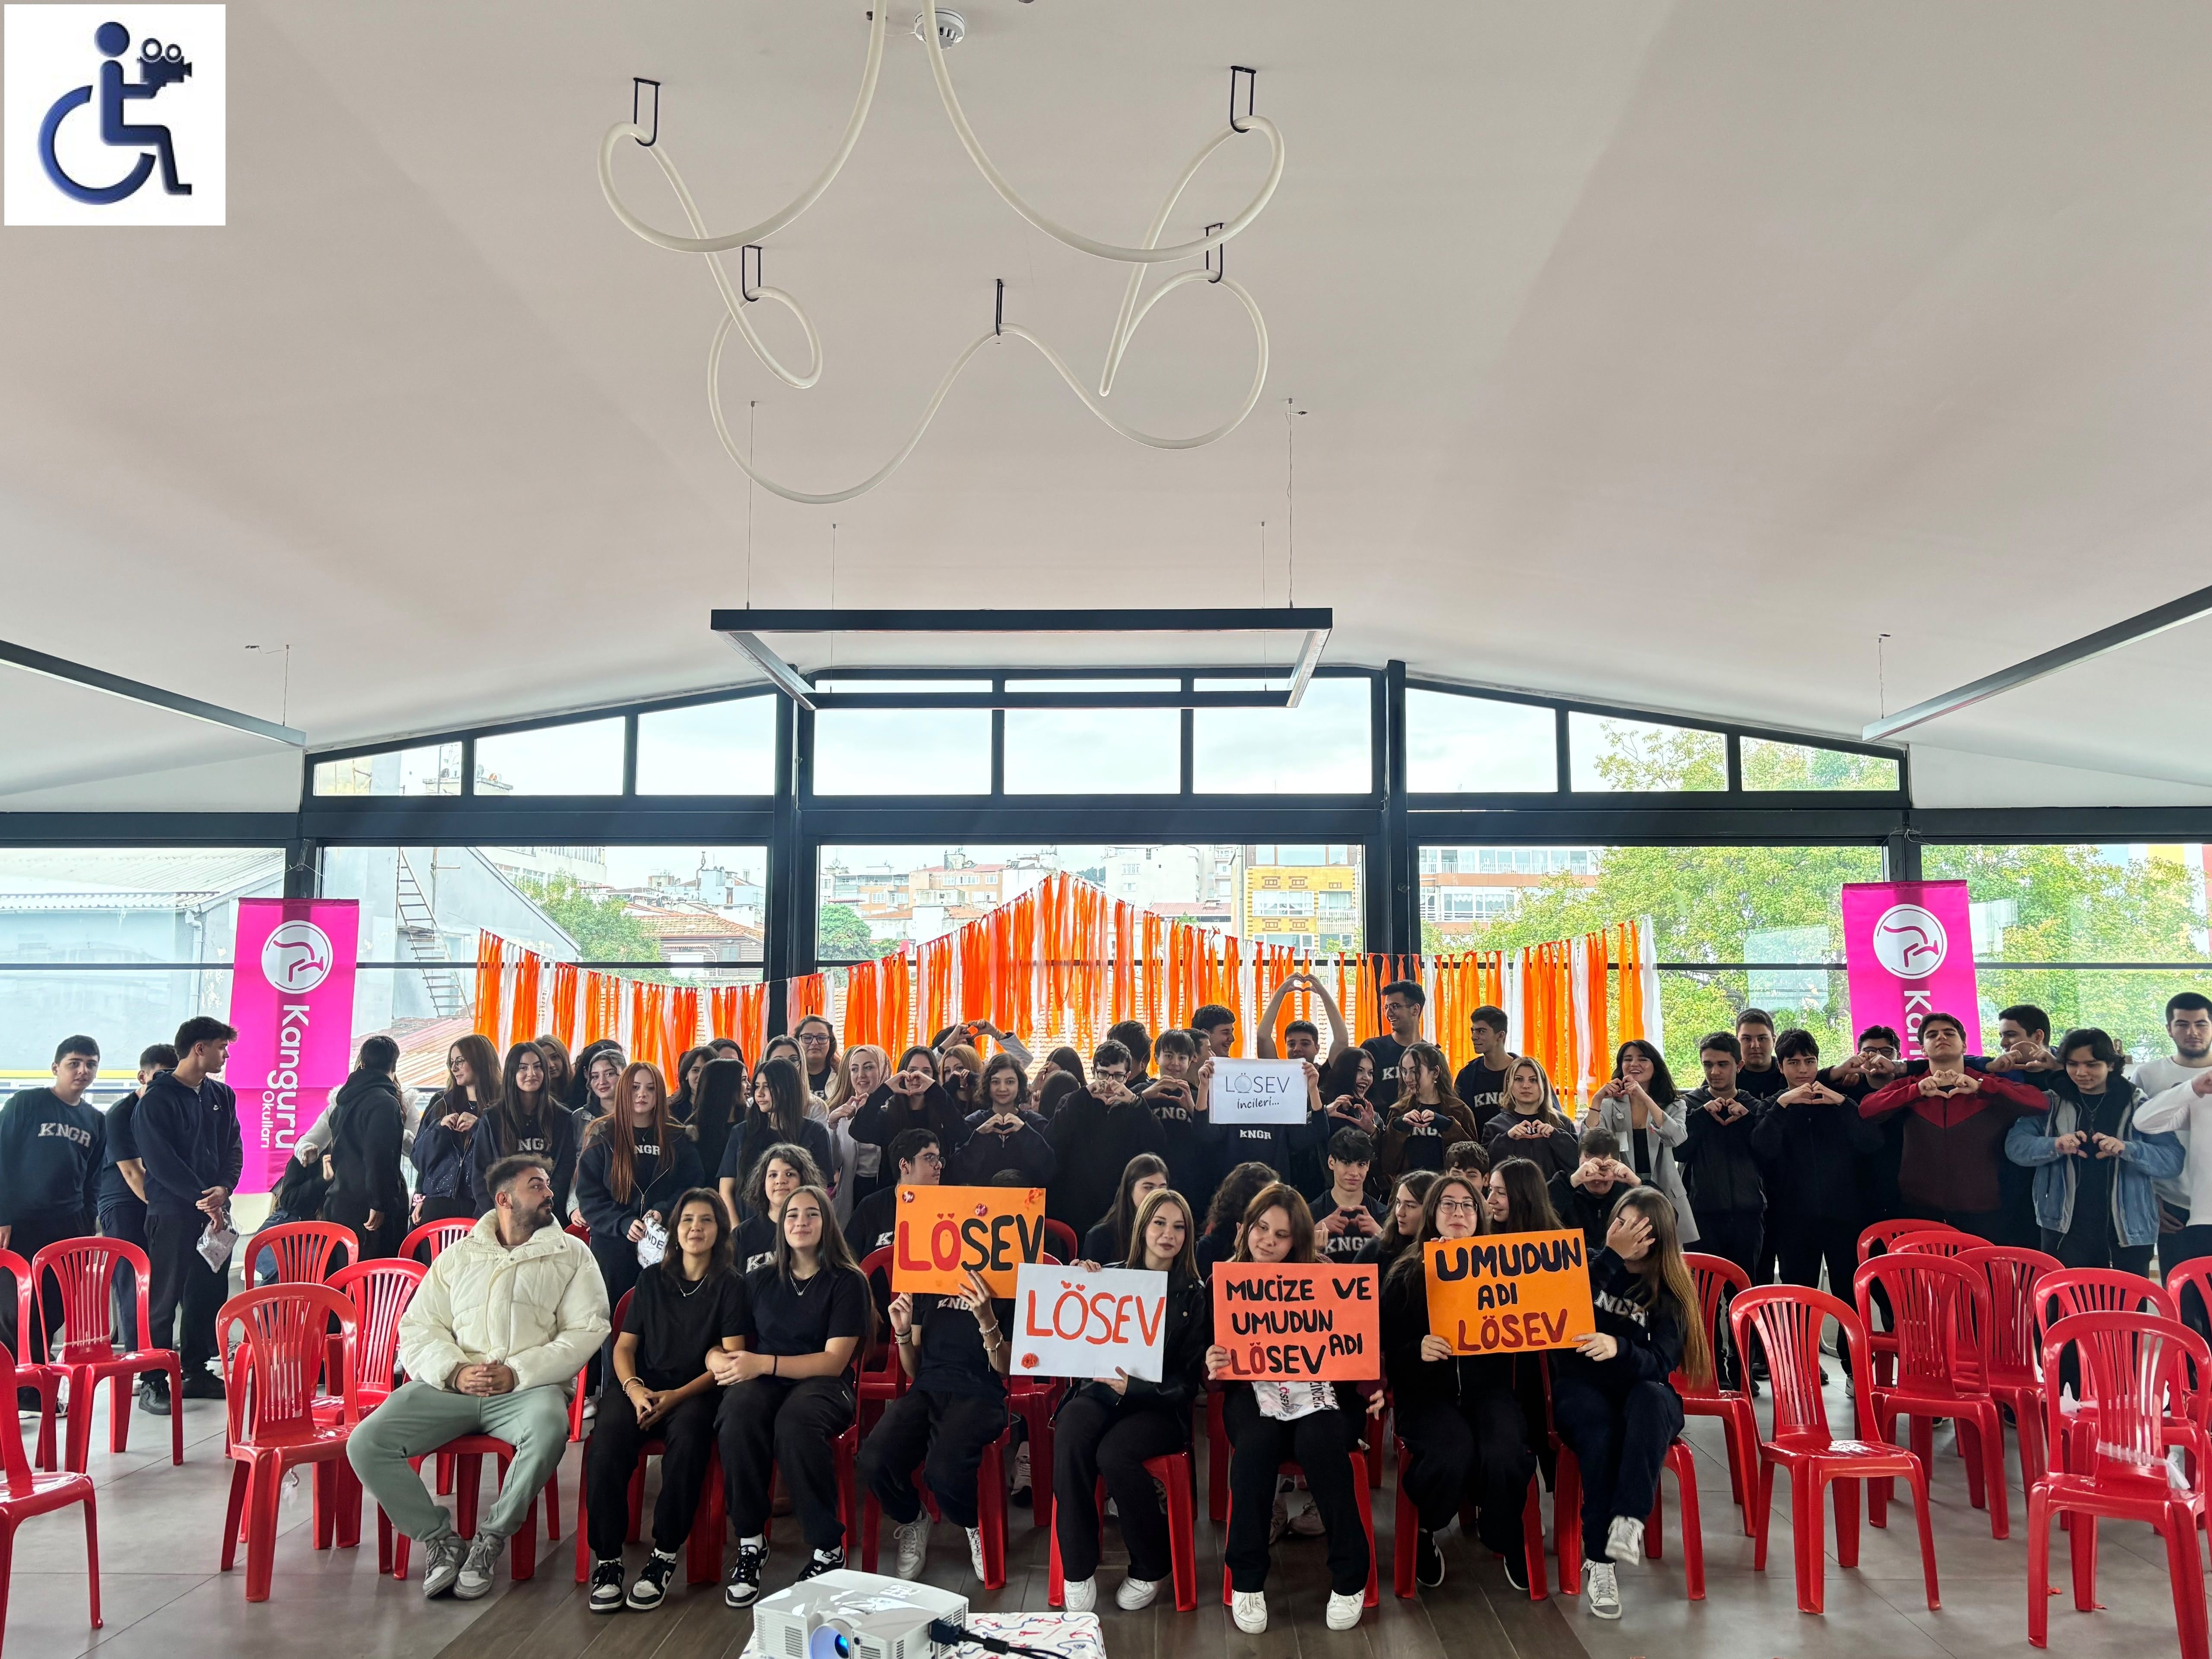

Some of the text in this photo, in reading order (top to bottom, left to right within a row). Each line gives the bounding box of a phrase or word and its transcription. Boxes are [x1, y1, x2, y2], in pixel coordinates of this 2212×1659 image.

[267, 1004, 310, 1149] Kanguru
[1226, 1072, 1290, 1093] LÖSEV
[1153, 1107, 1192, 1123] KNG
[39, 1122, 91, 1148] KNGR
[1239, 1129, 1271, 1140] KNGR
[634, 1144, 660, 1156] NGR
[898, 1213, 1044, 1271] LÖSEV
[1323, 1236, 1372, 1255] KNG
[1435, 1237, 1582, 1281] UMUDUN
[1226, 1274, 1372, 1302] MUCİZE VE
[1478, 1282, 1518, 1310] ADI
[1026, 1280, 1166, 1347] LÖSEV
[1231, 1309, 1333, 1335] UMUDUN
[1458, 1308, 1568, 1351] LÖSEV
[1230, 1341, 1326, 1375] LÖSEV
[1328, 1333, 1363, 1357] ADI
